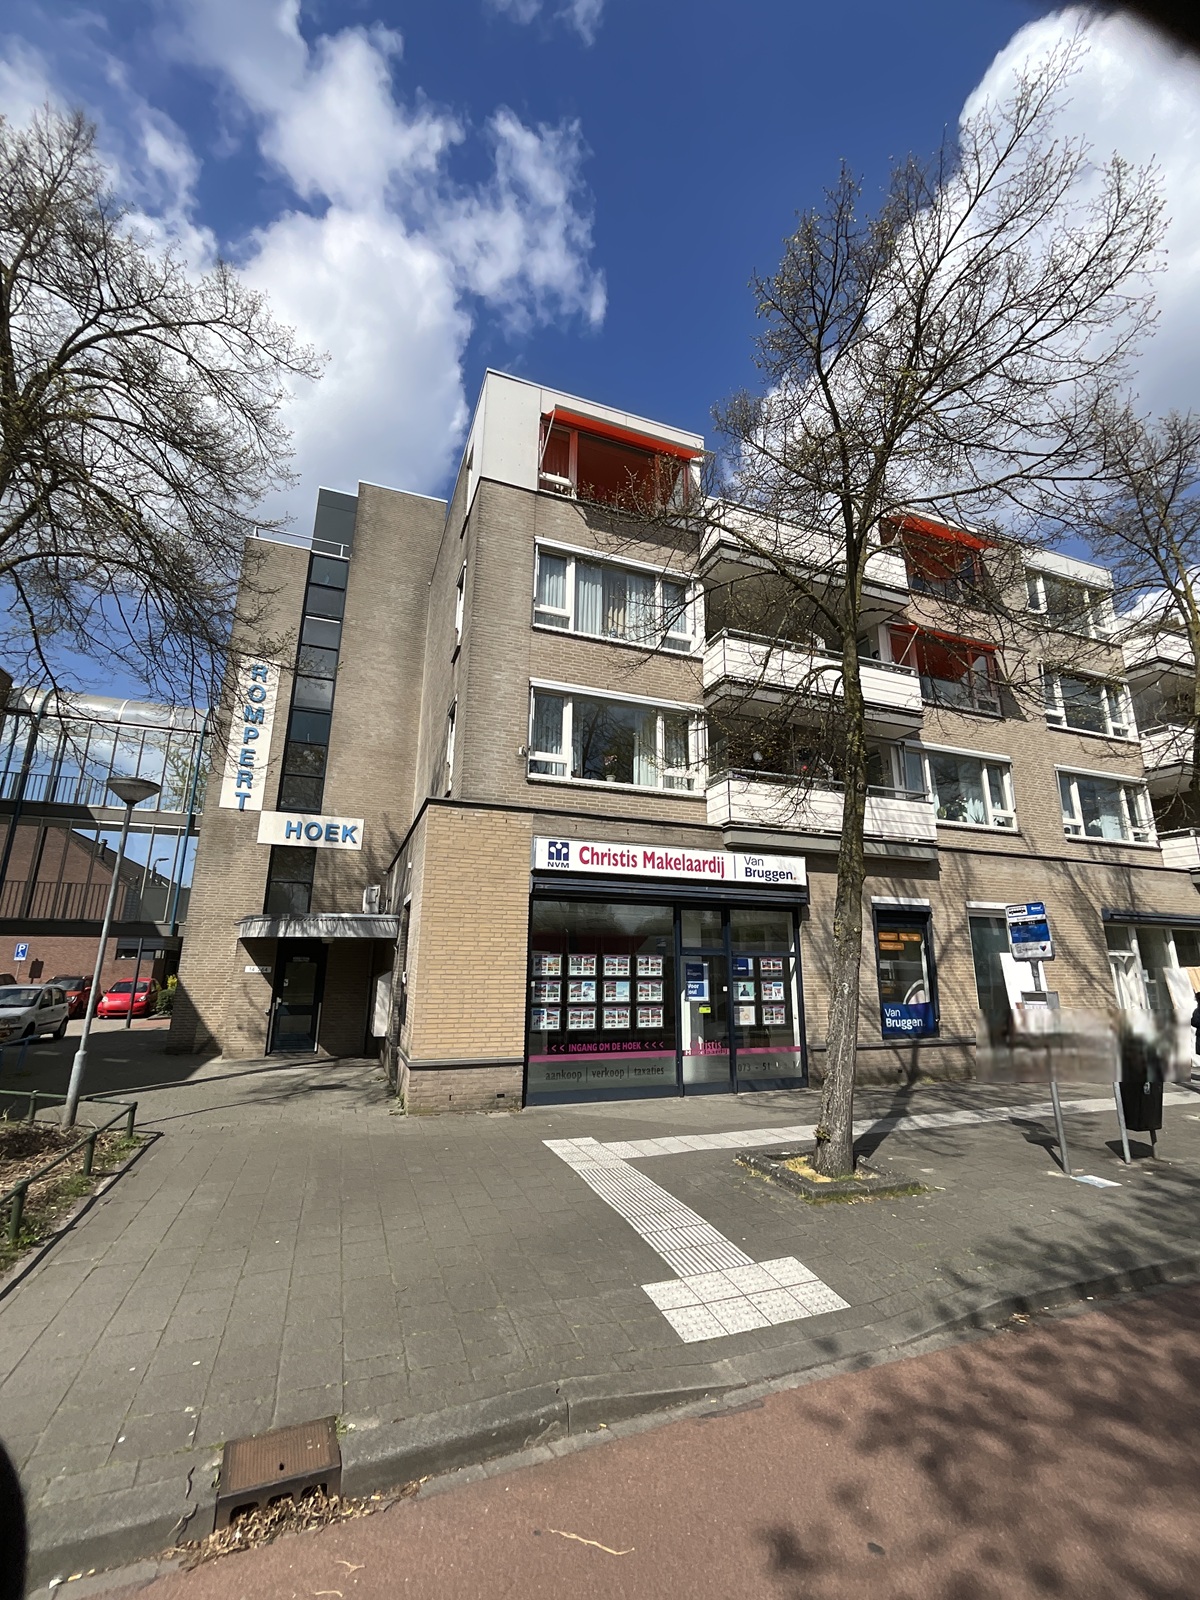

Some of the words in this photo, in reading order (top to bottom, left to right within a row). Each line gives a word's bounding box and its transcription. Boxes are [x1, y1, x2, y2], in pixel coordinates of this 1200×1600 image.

[234, 663, 268, 812] ROMPERT
[285, 820, 358, 844] HOEK
[547, 861, 570, 869] NVM
[578, 845, 638, 869] Christis
[642, 850, 726, 879] Makelaardij
[743, 855, 764, 867] Van
[744, 867, 797, 882] Bruggen.
[18, 944, 26, 952] P
[884, 1008, 901, 1017] Van
[568, 1042, 598, 1052] INGANG
[598, 1042, 610, 1051] OM
[611, 1041, 621, 1051] DE
[622, 1041, 642, 1050] HOEK
[545, 1069, 582, 1083] aankoop
[591, 1066, 625, 1079] verkoop
[633, 1064, 665, 1076] taxaties
